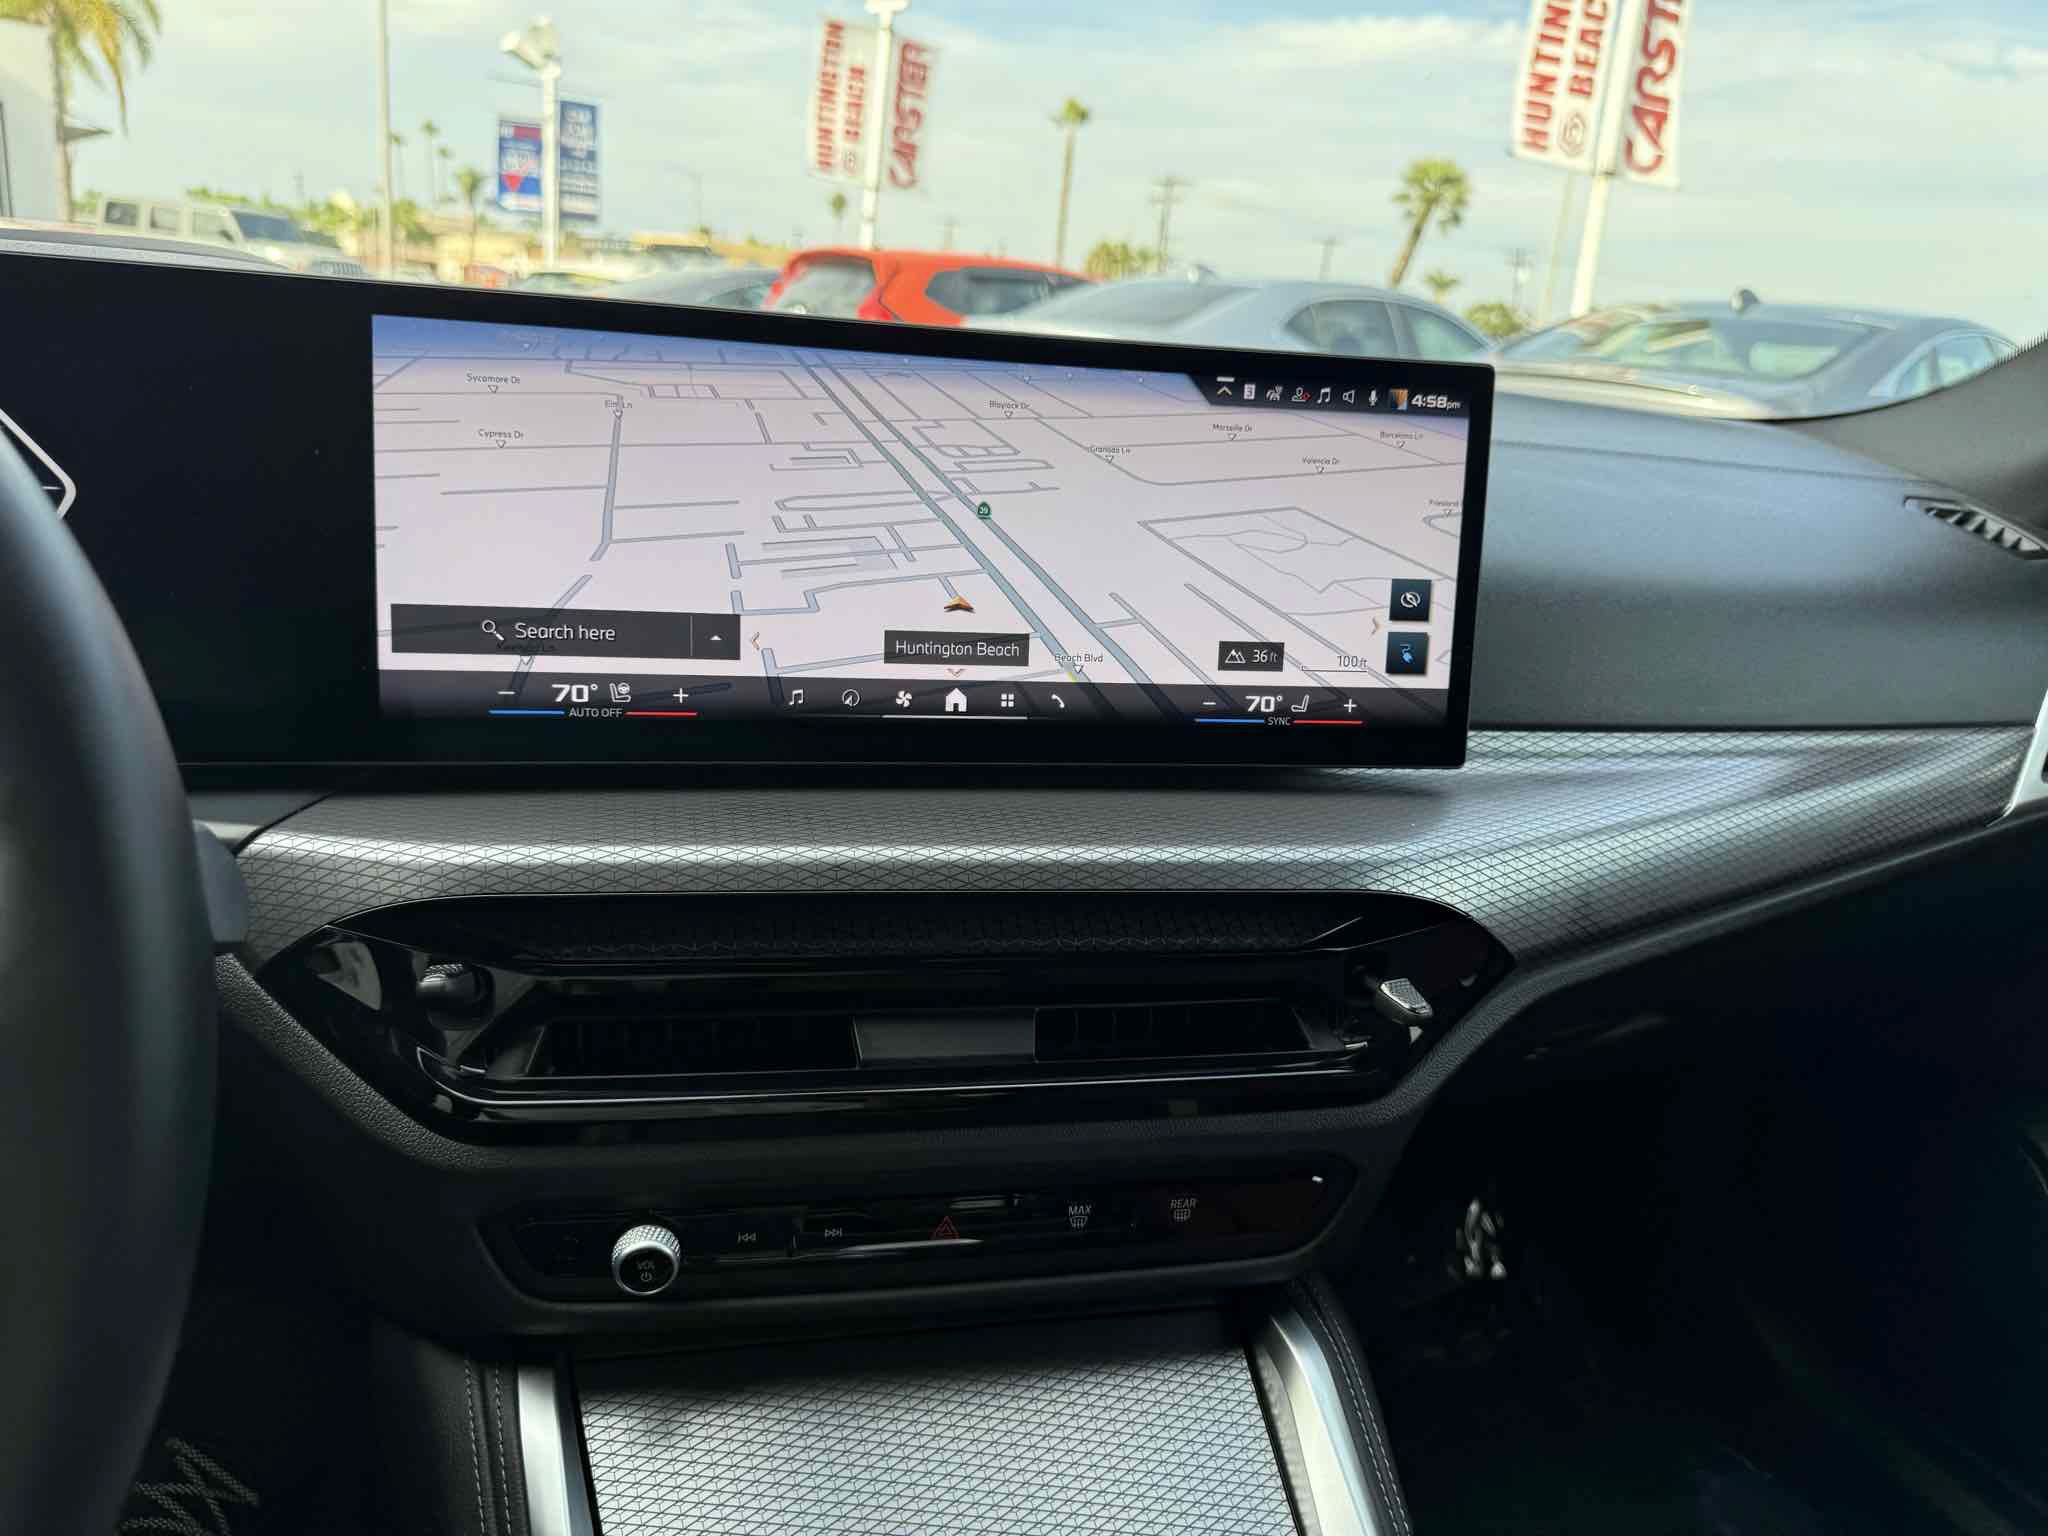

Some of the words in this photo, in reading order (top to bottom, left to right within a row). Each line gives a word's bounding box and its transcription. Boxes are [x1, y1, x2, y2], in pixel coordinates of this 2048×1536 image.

[1522, 0, 1571, 151] HUNTIN
[1625, 0, 1682, 173] CARST
[1411, 394, 1461, 411] 4:58pm
[478, 428, 512, 440] Cypress
[514, 622, 574, 640] Search
[578, 625, 616, 641] here
[895, 639, 973, 658] Huntington
[977, 641, 1020, 657] Beach
[1055, 653, 1082, 662] Beach
[1084, 653, 1104, 663] Blvd
[1252, 649, 1268, 663] 36
[1269, 650, 1278, 663] ft
[1337, 655, 1358, 668] 100
[568, 708, 599, 717] AUTO
[601, 708, 623, 718] OFF
[1267, 717, 1291, 726] SYNC
[1170, 1198, 1197, 1208] REAR
[1068, 1205, 1092, 1216] MAX
